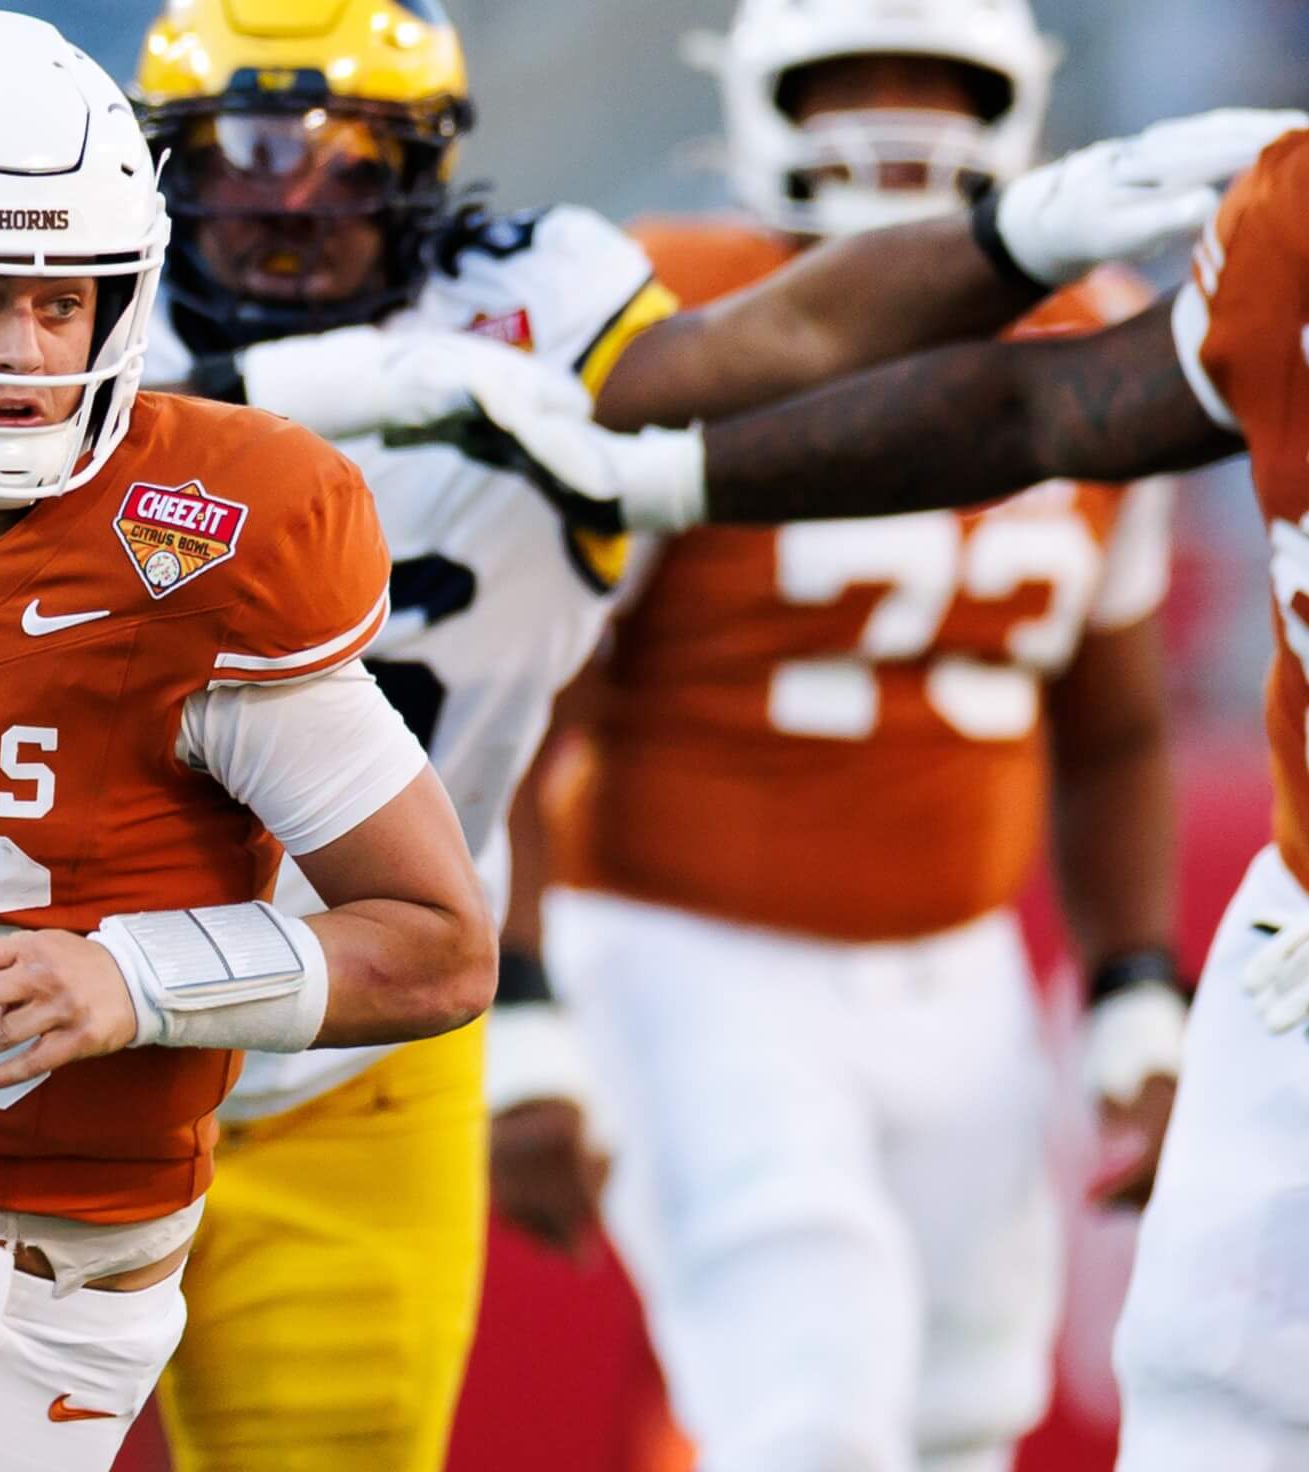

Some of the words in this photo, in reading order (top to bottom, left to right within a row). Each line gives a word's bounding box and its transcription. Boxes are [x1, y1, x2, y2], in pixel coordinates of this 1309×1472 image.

[130, 525, 174, 546] CITRUS
[178, 537, 211, 557] BOWL
[769, 510, 1102, 740] 73
